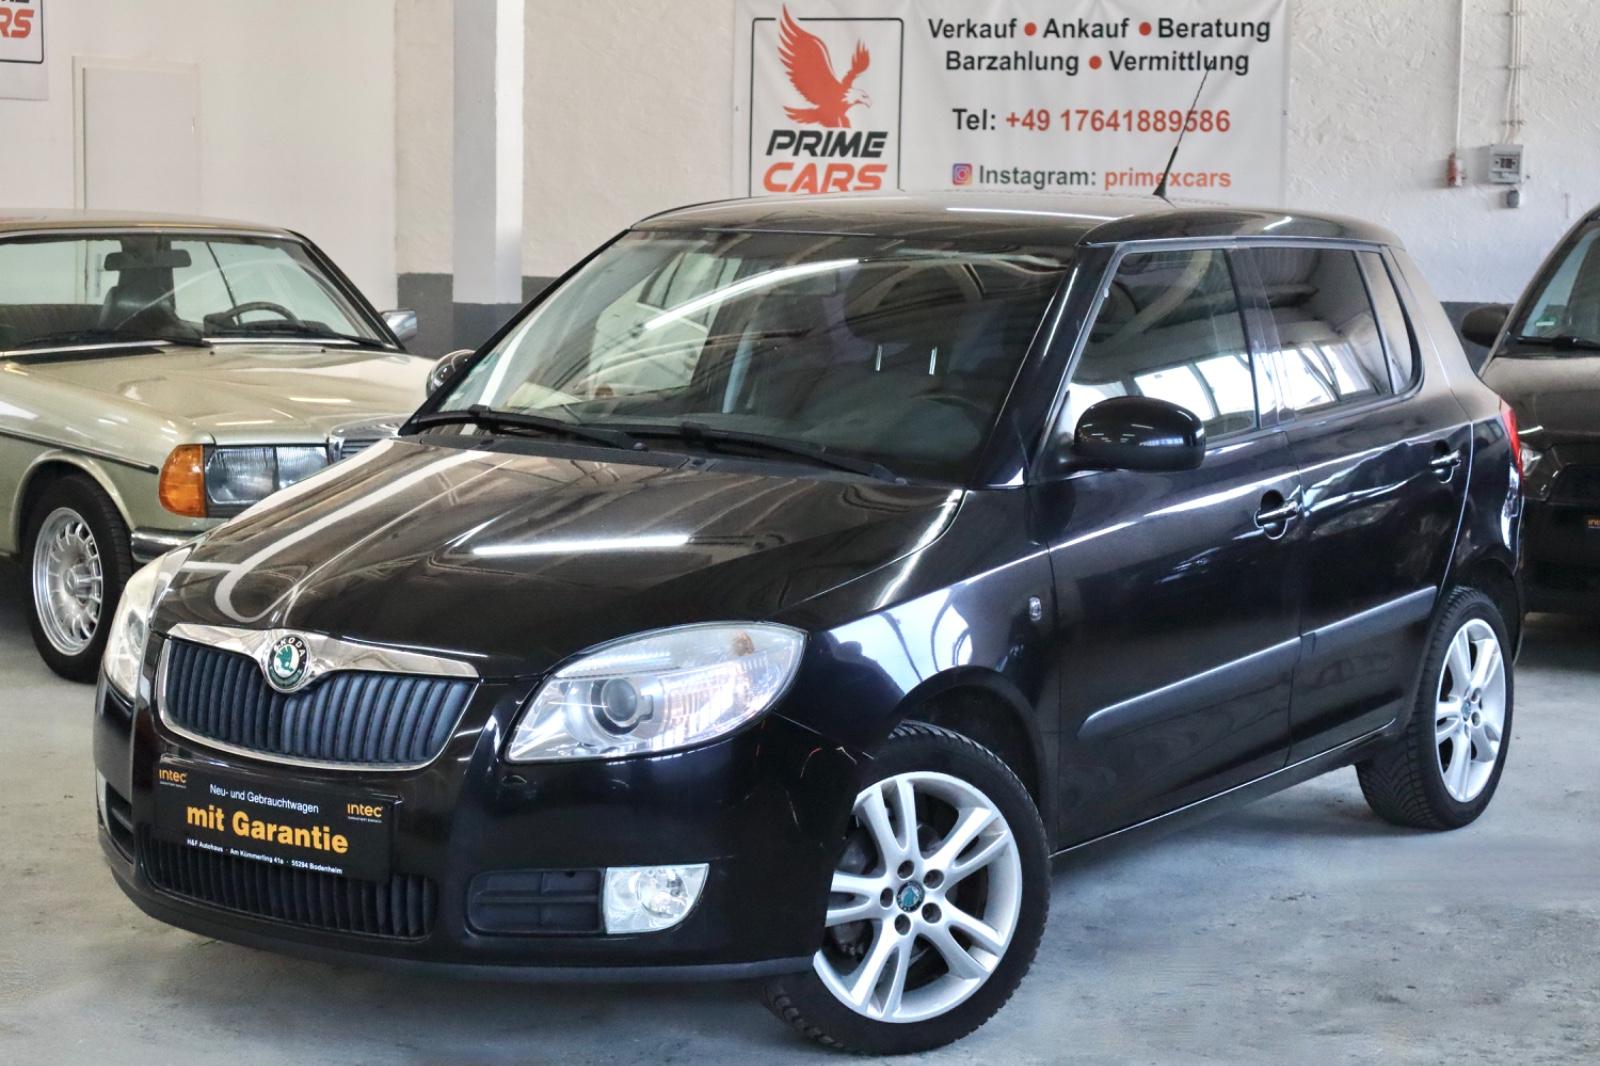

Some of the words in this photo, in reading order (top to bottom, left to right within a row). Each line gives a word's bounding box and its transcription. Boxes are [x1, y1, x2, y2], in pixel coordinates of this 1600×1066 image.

[928, 18, 1018, 39] Verkauf
[1043, 18, 1130, 39] Ankauf
[1158, 17, 1271, 43] Beratung
[946, 50, 1079, 76] Barzahlung
[1109, 50, 1249, 76] Vermittlung
[952, 108, 996, 131] Tel:
[1006, 109, 1051, 132] +49
[1060, 109, 1231, 133] 17641889586
[765, 129, 889, 158] PRIME
[763, 162, 888, 194] CARS
[979, 165, 1096, 190] Instagram:
[209, 783, 229, 797] Neu-
[230, 789, 245, 801] und
[247, 791, 319, 814] Gebrauchtwagen
[186, 804, 225, 832] mit
[232, 810, 349, 854] Garantie
[199, 841, 224, 853] Autohaus
[230, 847, 240, 856] Am
[309, 862, 343, 875] Bodenheim
